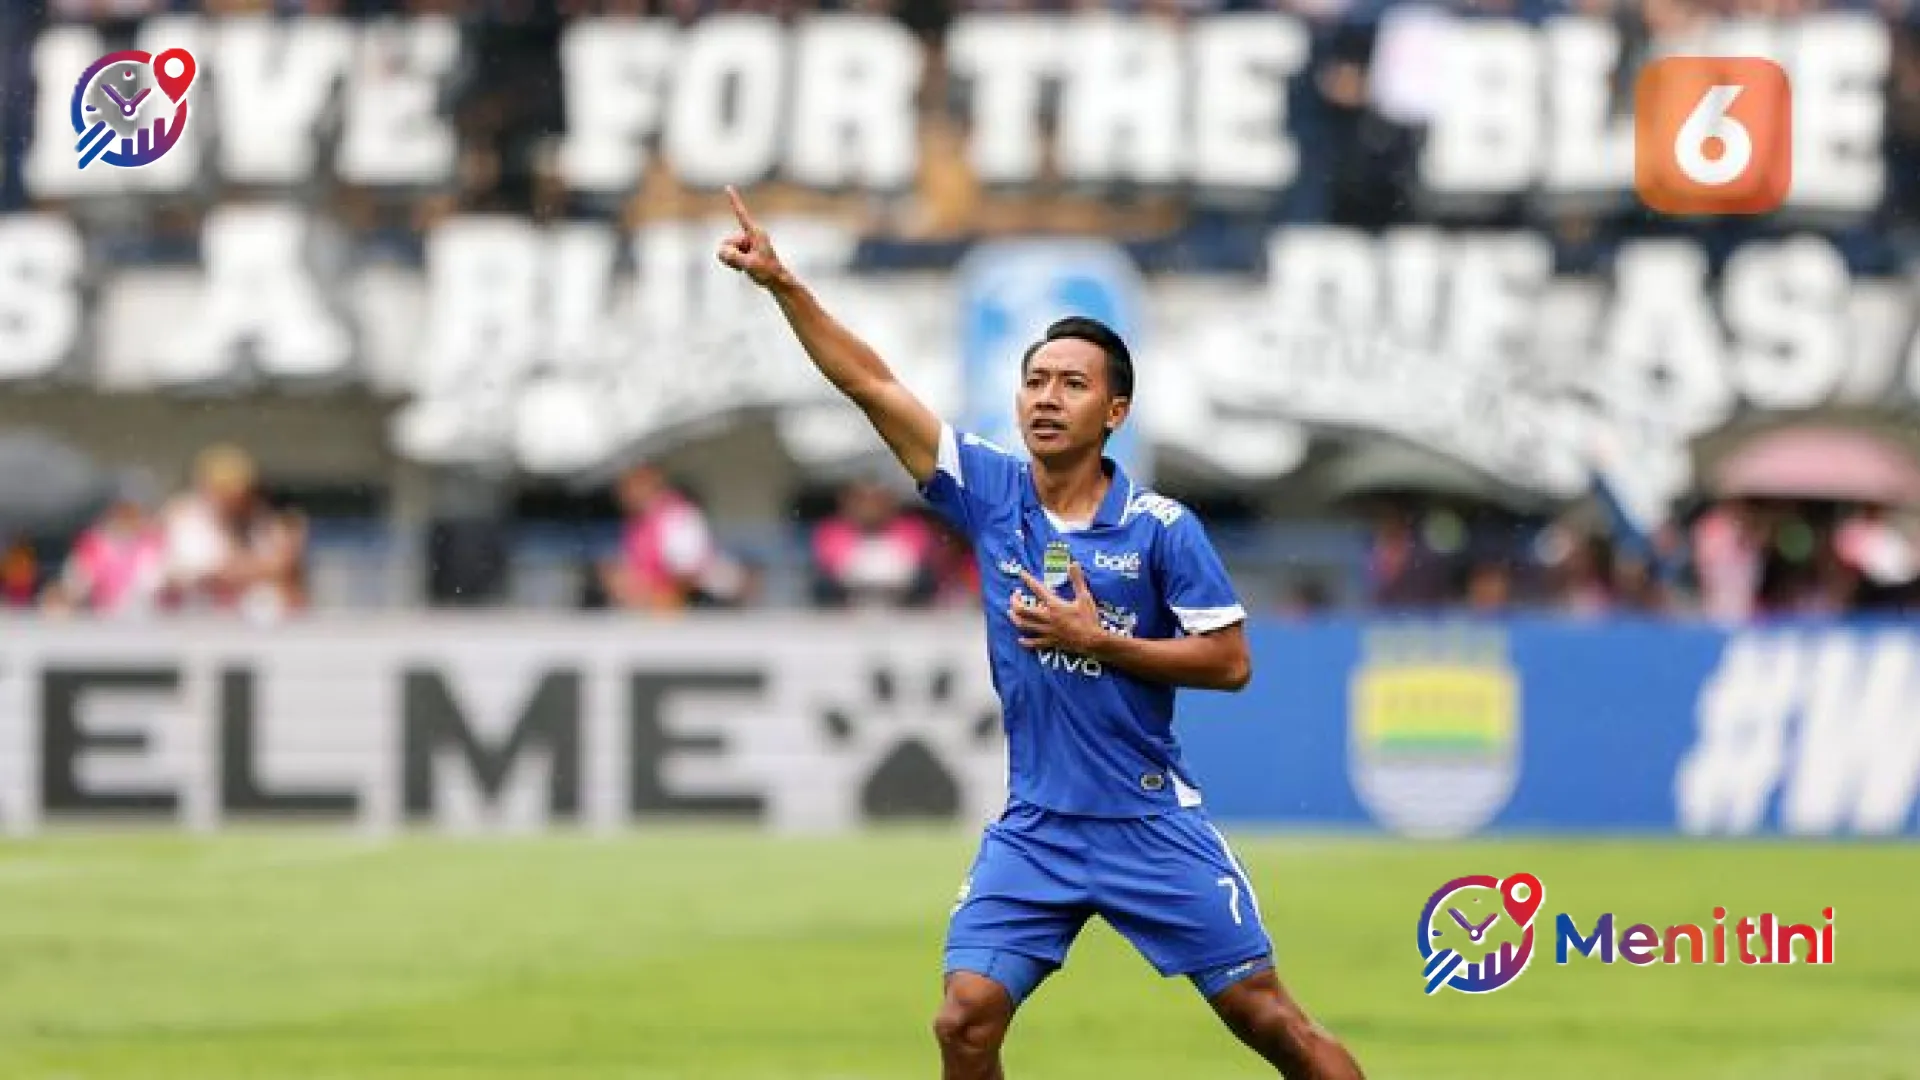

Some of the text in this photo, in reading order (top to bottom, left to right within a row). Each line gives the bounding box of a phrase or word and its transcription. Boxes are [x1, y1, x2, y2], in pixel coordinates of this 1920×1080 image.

[560, 18, 922, 192] FOR
[948, 16, 1308, 190] THE
[1420, 18, 1890, 212] BLE
[1600, 236, 1852, 435] AS
[1217, 877, 1242, 925] 7
